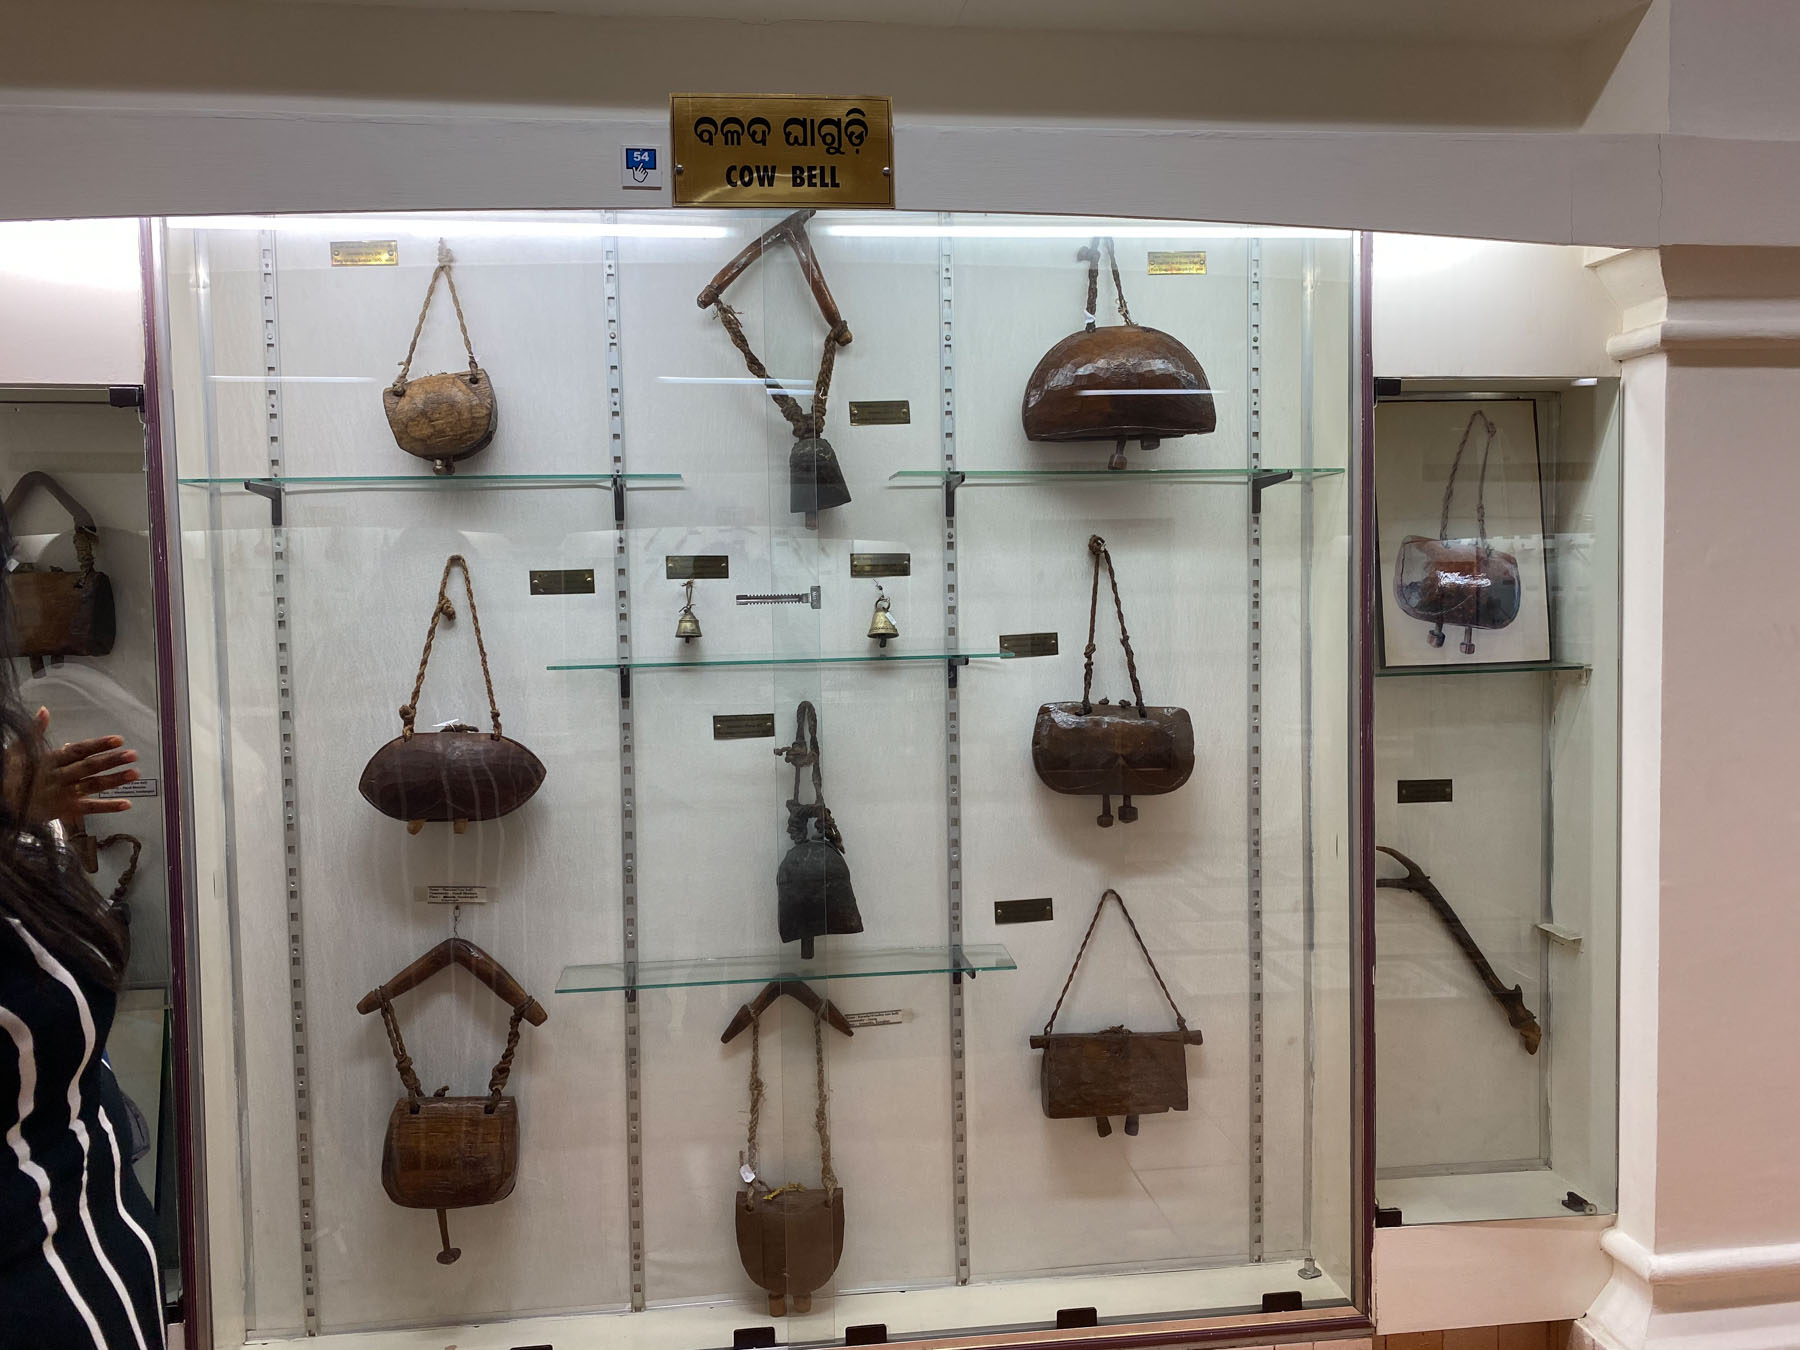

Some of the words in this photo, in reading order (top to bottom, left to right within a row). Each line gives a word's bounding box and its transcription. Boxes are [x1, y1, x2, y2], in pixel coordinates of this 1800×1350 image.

[694, 116, 771, 147] ବଳଦ
[633, 151, 650, 162] 54
[726, 164, 777, 188] COW
[791, 165, 841, 188] BELL
